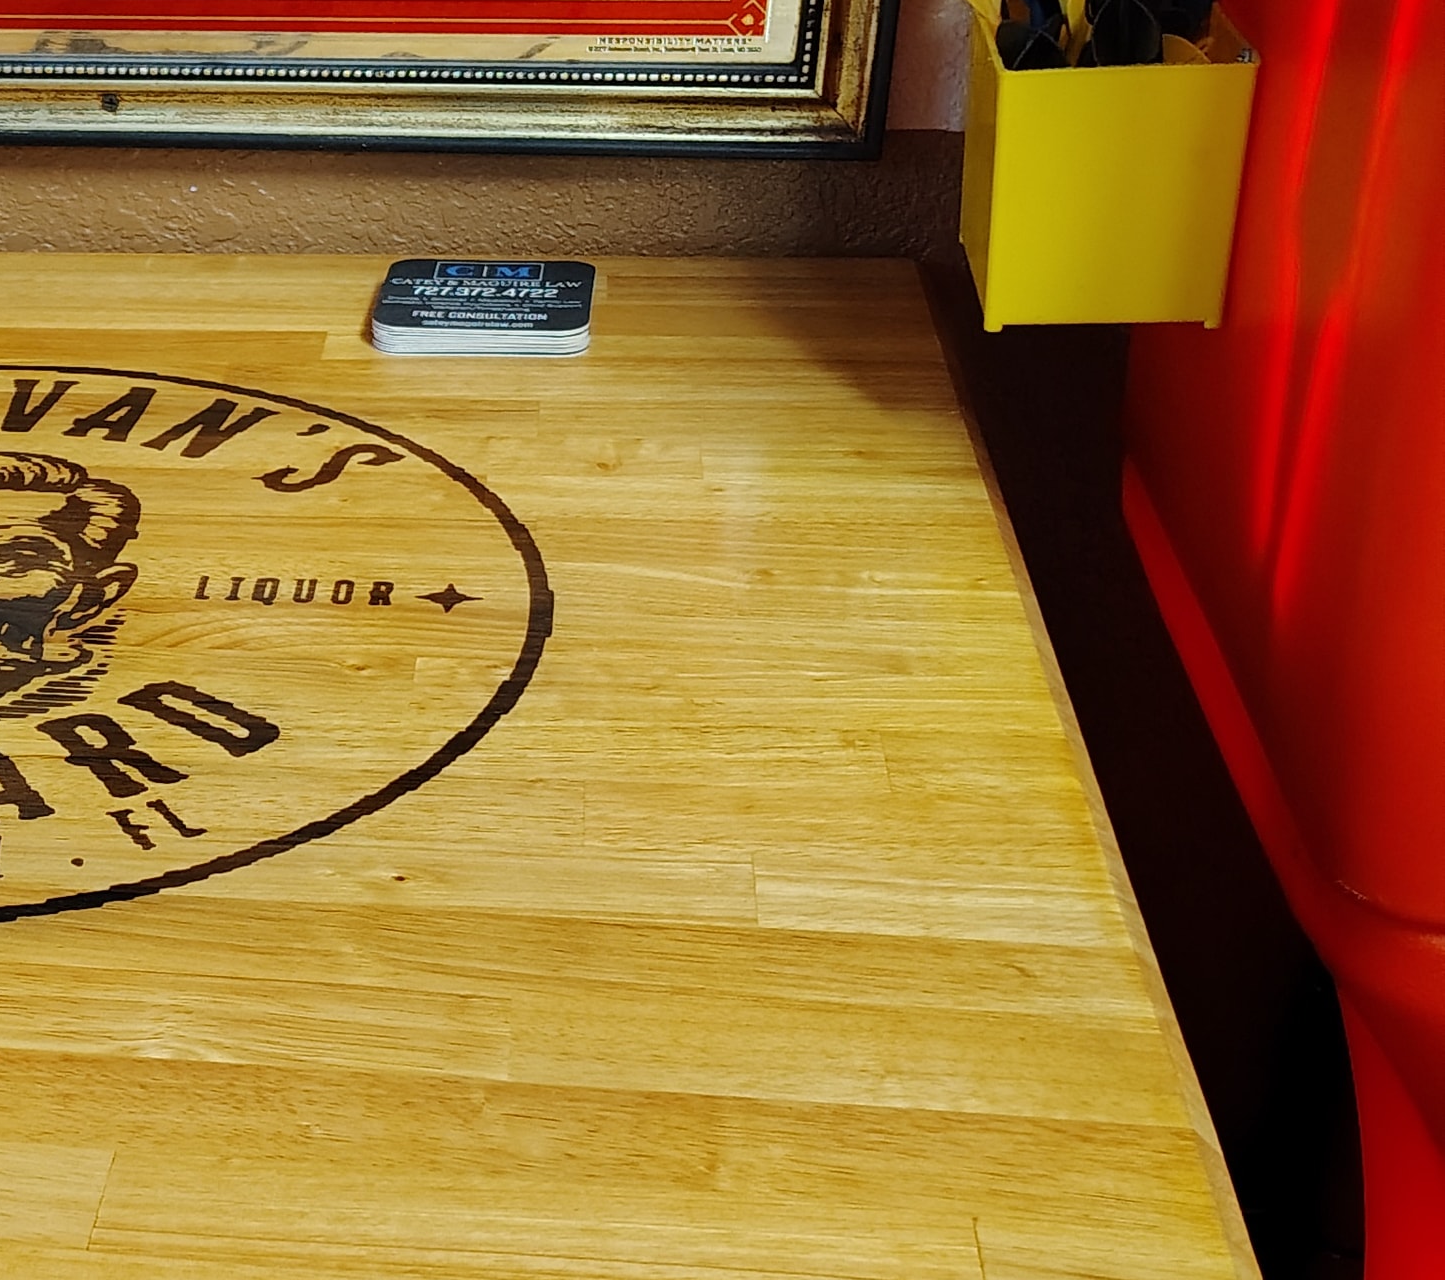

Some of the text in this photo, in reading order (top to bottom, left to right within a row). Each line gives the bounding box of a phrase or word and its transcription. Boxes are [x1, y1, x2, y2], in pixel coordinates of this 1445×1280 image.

[445, 265, 533, 277] C M
[412, 285, 559, 298] 727.372.4722
[412, 310, 548, 321] FREE CONSULTATION
[192, 575, 395, 607] LIQUOR
[106, 799, 208, 850] FL
